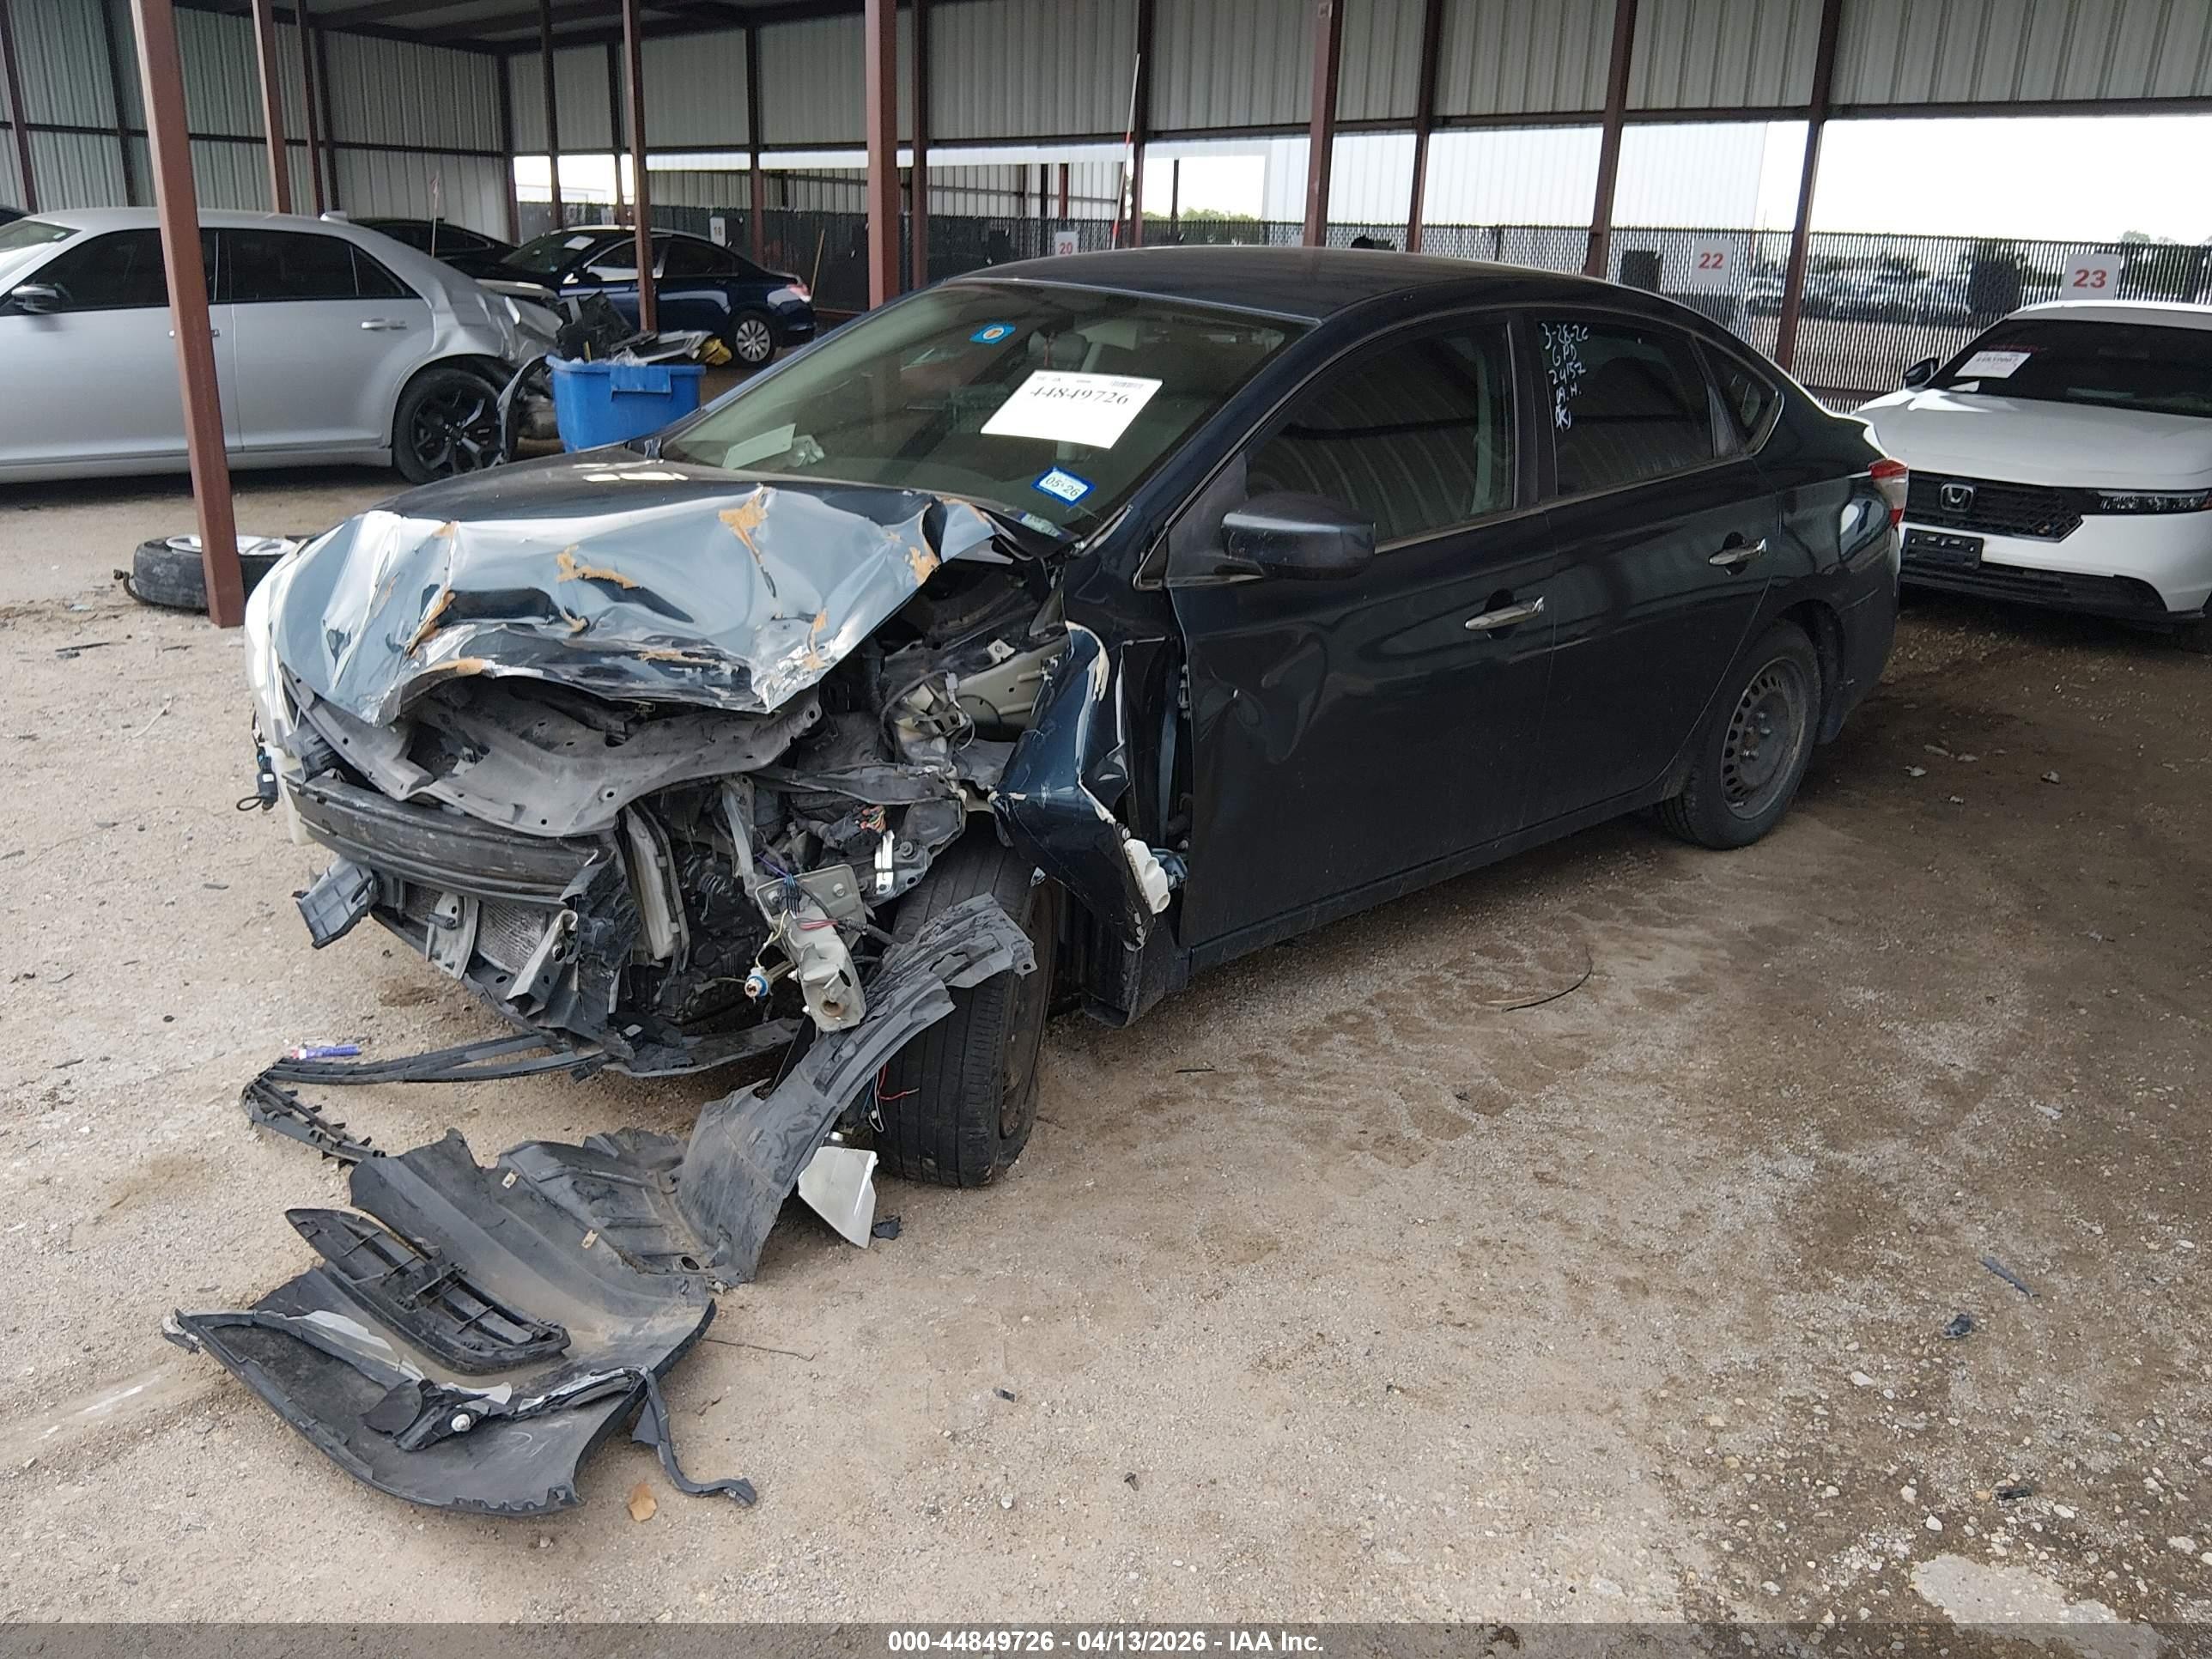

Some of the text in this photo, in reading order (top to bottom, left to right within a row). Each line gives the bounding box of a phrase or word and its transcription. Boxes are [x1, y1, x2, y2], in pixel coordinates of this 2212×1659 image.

[1059, 241, 1073, 255] 20
[1698, 252, 1724, 270] 22
[2072, 269, 2107, 289] 23
[1030, 386, 1130, 405] 44849726
